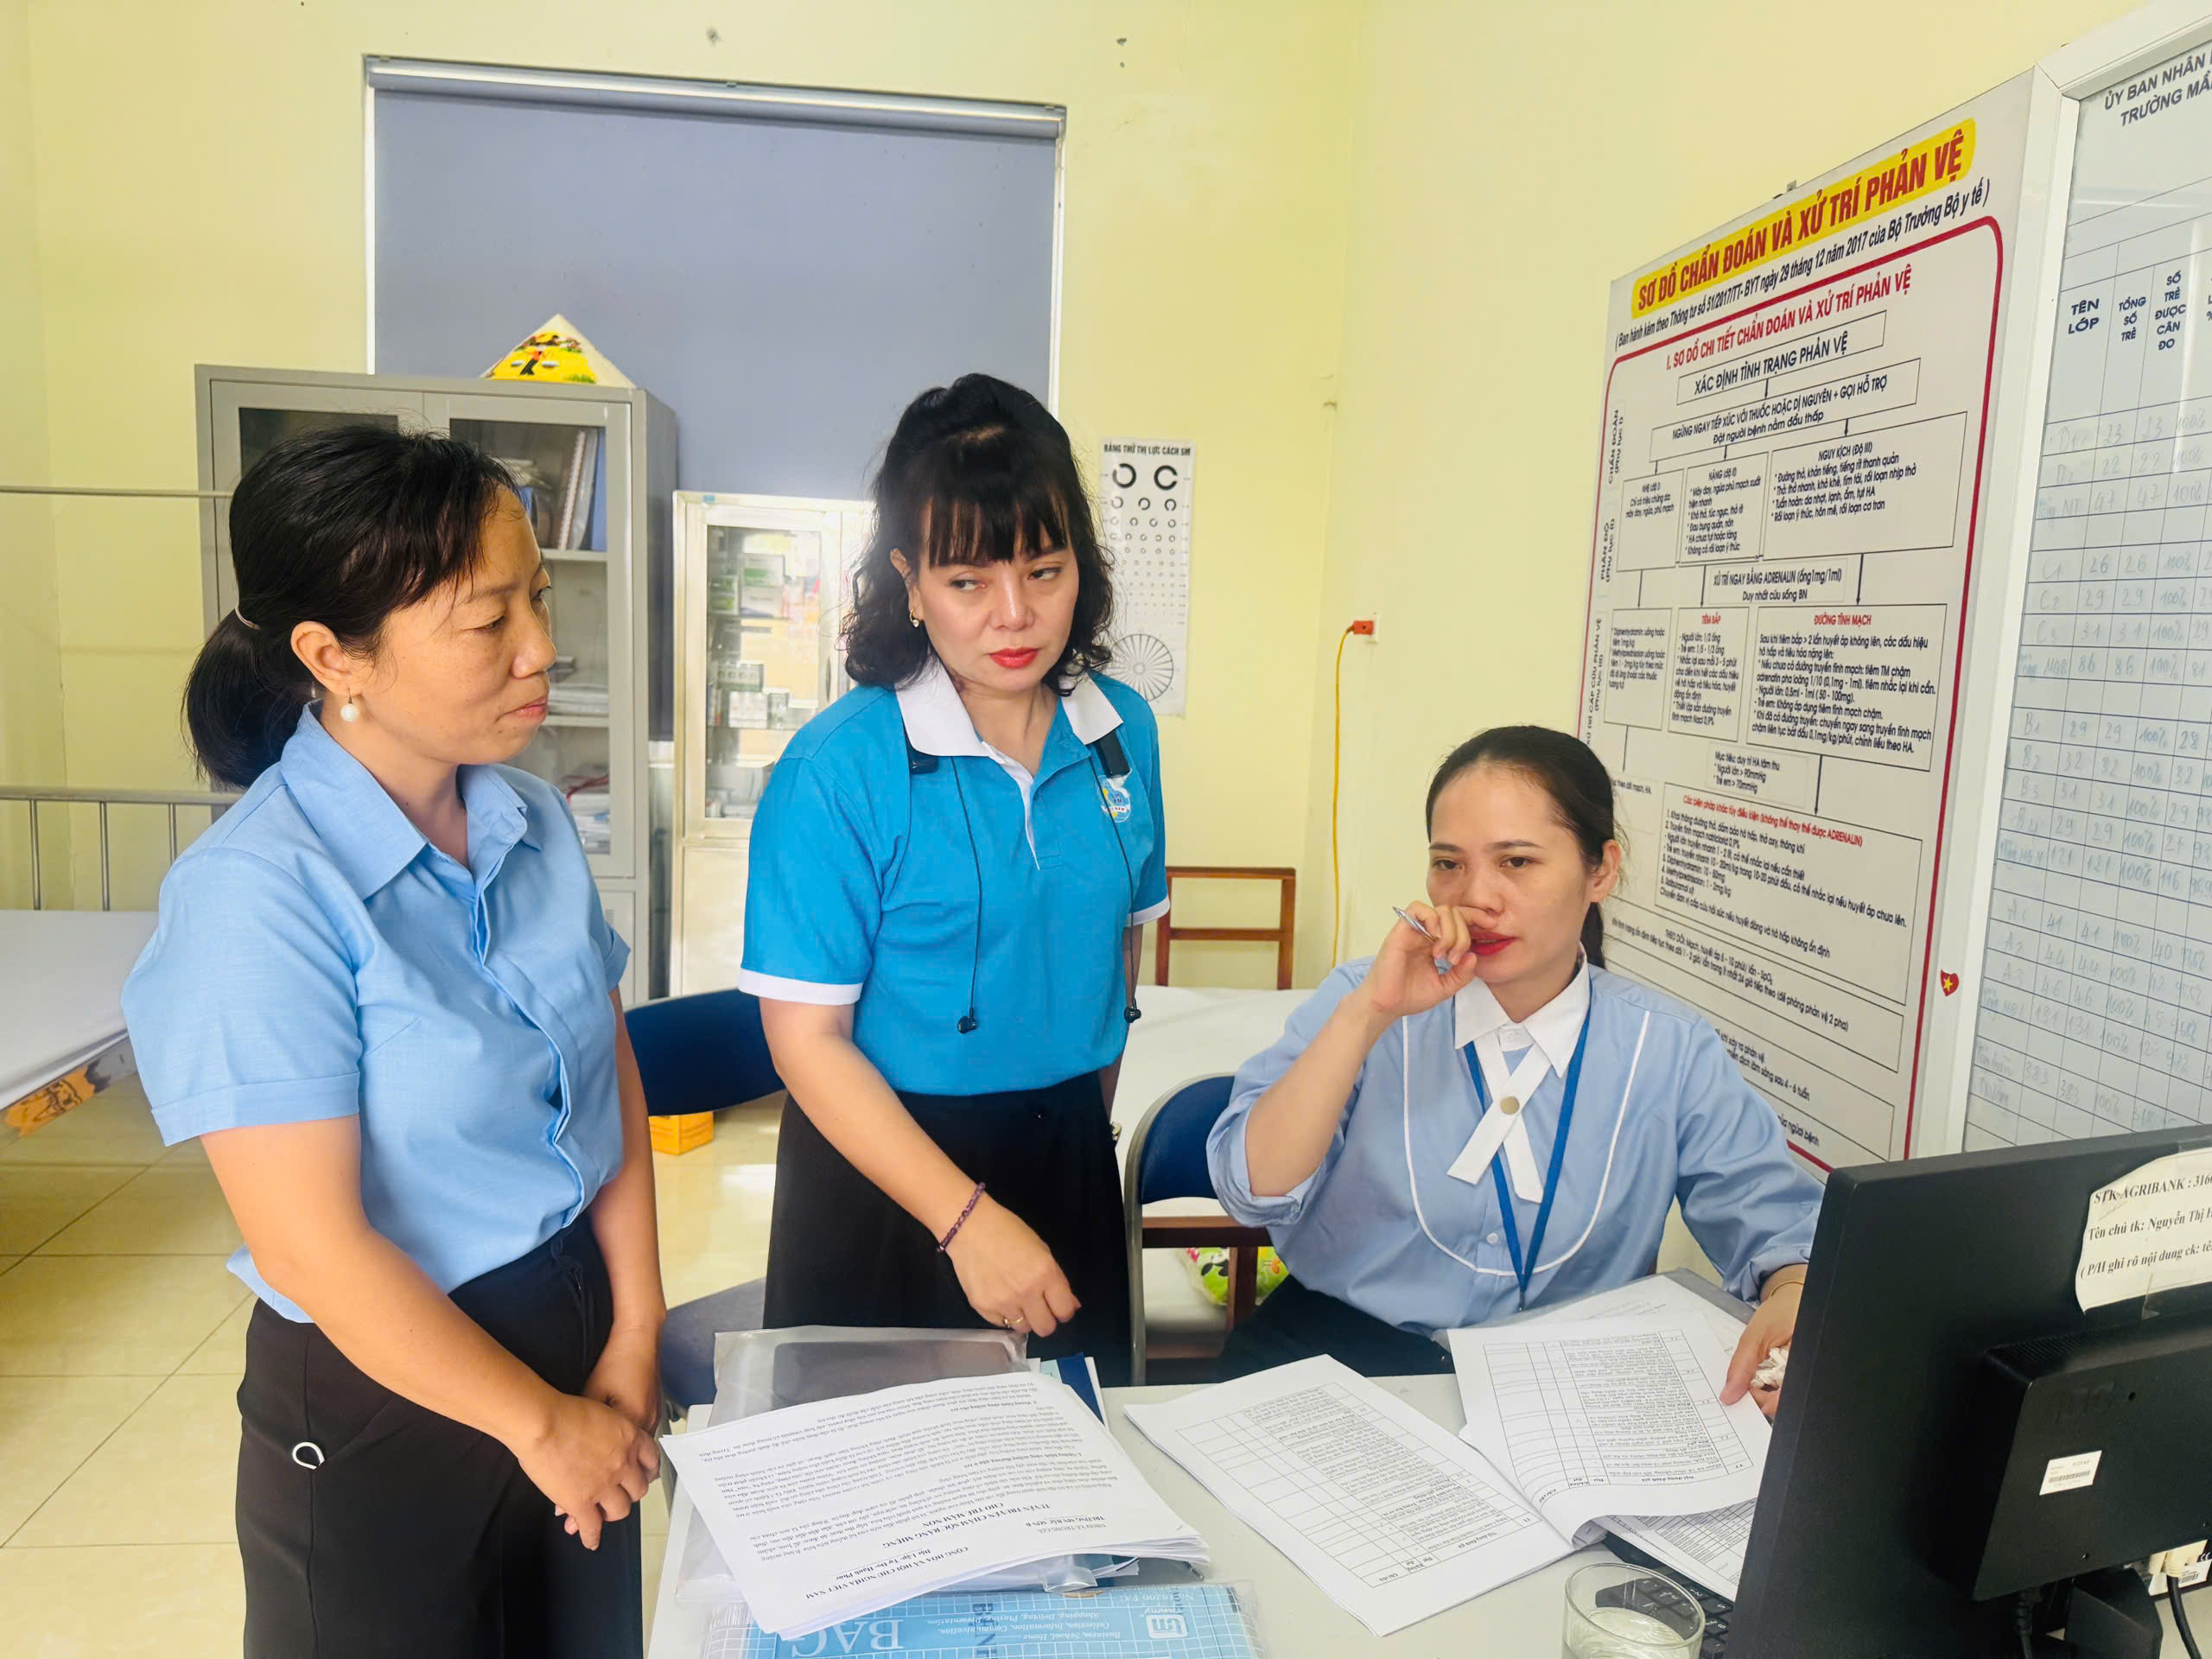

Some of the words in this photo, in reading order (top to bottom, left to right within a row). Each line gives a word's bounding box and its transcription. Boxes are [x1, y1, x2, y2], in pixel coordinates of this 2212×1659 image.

[2105, 90, 2124, 110] ỦY
[2127, 74, 2158, 101] BAN
[2162, 53, 2206, 86] NHÂN
[2120, 88, 2183, 127] TRƯỜNG
[2186, 70, 2212, 99] MẦ
[1637, 277, 1657, 310] SƠ
[1658, 262, 1677, 302] ĐỒ
[1679, 244, 1719, 292] CHẨN
[1722, 226, 1767, 274] ĐOÁN
[1771, 210, 1792, 251] VÀ
[1796, 188, 1827, 241] XỬ
[1829, 176, 1861, 227] TRÍ
[1864, 148, 1927, 212] PHẢN
[1935, 128, 1964, 182] VỆ
[2166, 270, 2182, 286] SỐ
[2164, 287, 2181, 302] TRẺ
[2071, 298, 2100, 315] TÊN
[2119, 296, 2147, 312] TỔNG
[2155, 304, 2187, 321] ĐƯỢC
[1673, 348, 1685, 368] SƠ
[1686, 337, 1700, 364] ĐỒ
[1700, 338, 1715, 359] CHI
[1716, 325, 1736, 353] TIẾT
[1736, 312, 1764, 346] CHẨN
[1764, 308, 1796, 336] ĐOÁN
[1798, 299, 1813, 325] VÀ
[1815, 289, 1834, 320] XỬ
[1835, 283, 1855, 313] TRÍ
[1855, 270, 1891, 306] PHẢN
[1894, 263, 1912, 296] VỆ
[2124, 311, 2138, 326] SỐ
[2068, 316, 2099, 334] LỚP
[2157, 321, 2180, 335] CÂN
[2121, 327, 2137, 341] TRẺ
[2158, 339, 2175, 351] ĐO
[1694, 373, 1714, 395] XÁC
[1715, 368, 1738, 390] ĐỊNH
[1740, 360, 1761, 381] TÌNH
[1763, 349, 1797, 375] TRẠNG
[1799, 336, 1830, 364] PHẢN
[1833, 330, 1848, 355] VỆ
[1713, 431, 1726, 445] Đặt
[1726, 427, 1746, 442] người
[1746, 423, 1766, 437] bệnh
[1767, 417, 1785, 432] nằm
[1786, 412, 1803, 428] đầu
[1804, 408, 1824, 424] thấp
[2088, 1226, 2106, 1240] Tên
[2147, 1211, 2185, 1231] Nguyễn
[2189, 1209, 2205, 1224] Thị
[2107, 1258, 2124, 1274] ghi
[2141, 1252, 2156, 1267] nội
[2158, 1249, 2183, 1262] dung
